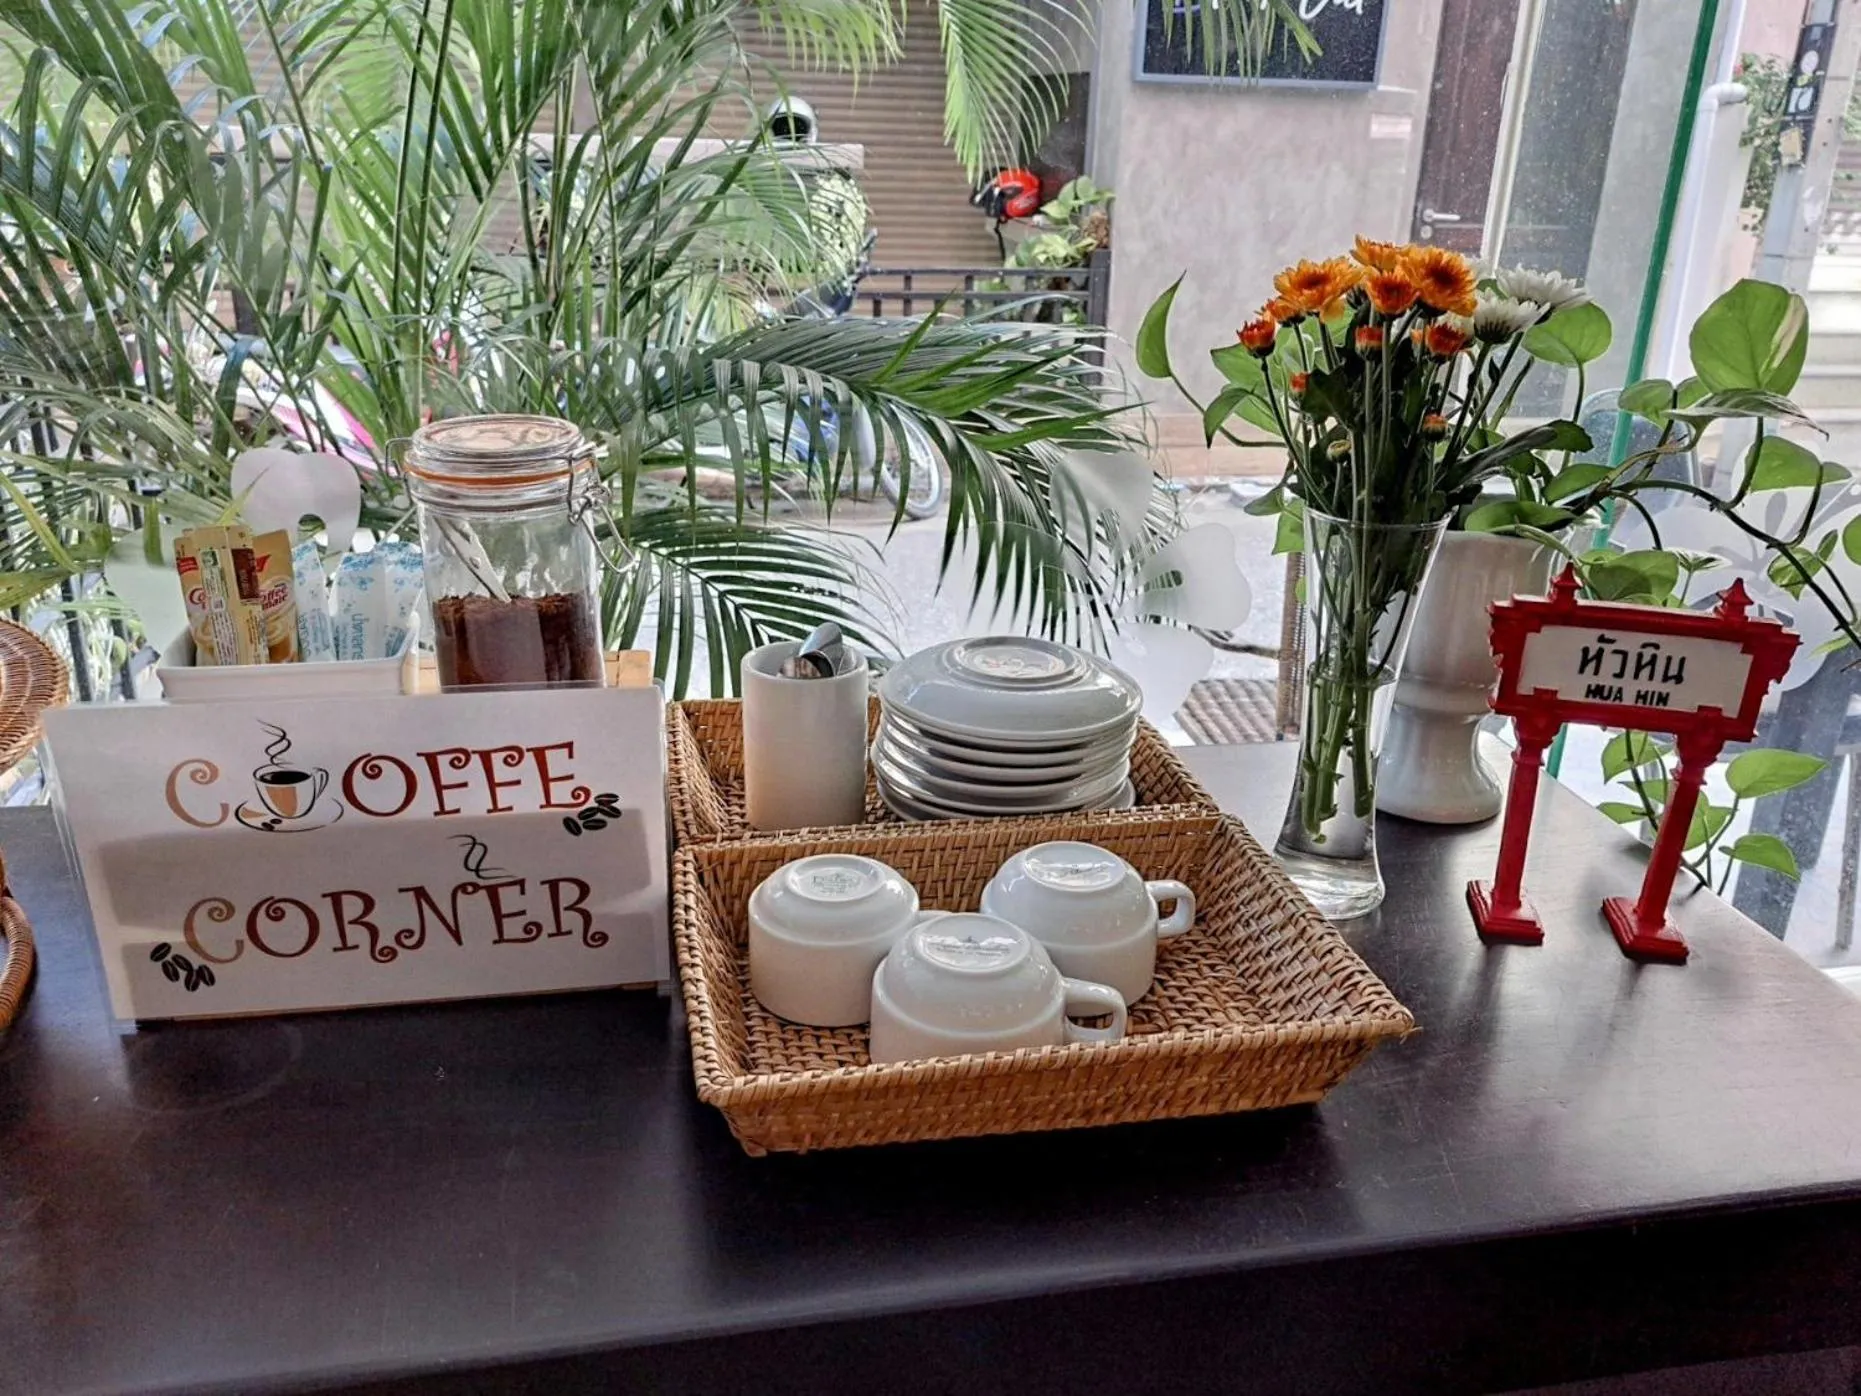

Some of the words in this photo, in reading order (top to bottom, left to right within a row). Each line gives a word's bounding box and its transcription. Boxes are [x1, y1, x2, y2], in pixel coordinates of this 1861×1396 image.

[1585, 683, 1623, 702] HUA
[1634, 689, 1670, 707] HIN
[183, 877, 609, 964] CORNER
